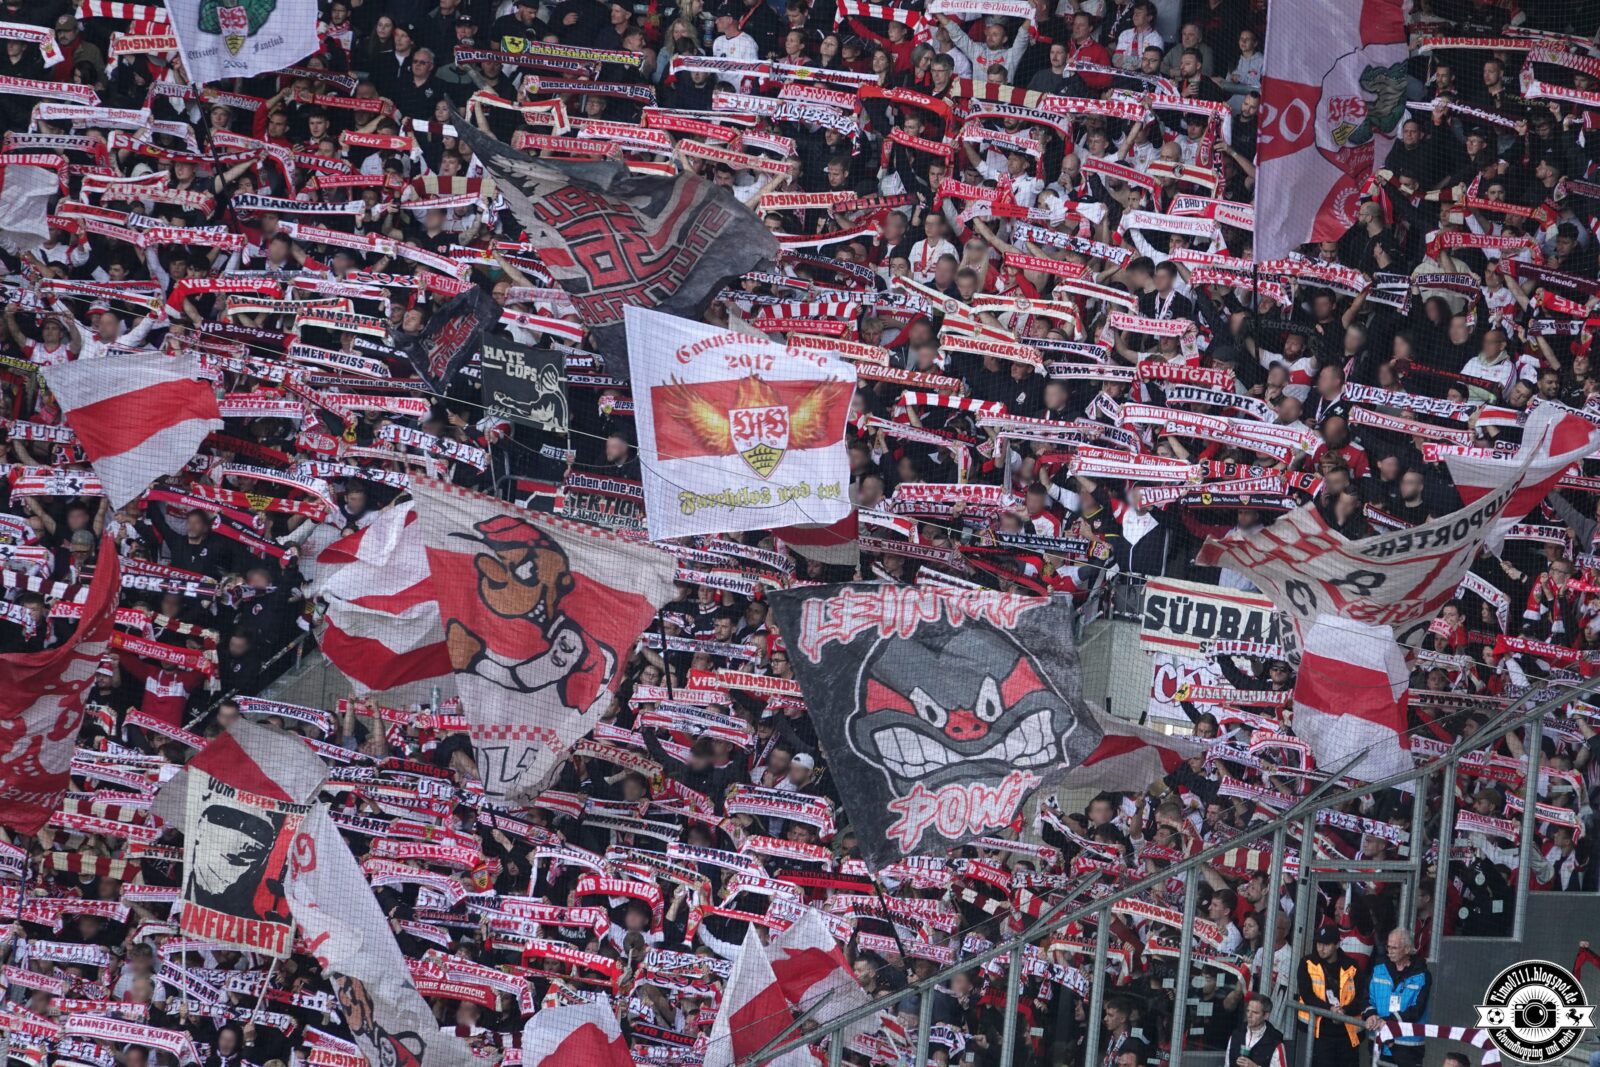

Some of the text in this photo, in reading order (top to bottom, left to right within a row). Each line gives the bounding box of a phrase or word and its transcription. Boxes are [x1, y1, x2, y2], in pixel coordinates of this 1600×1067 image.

[1218, 210, 1253, 225] FANUC
[182, 277, 212, 288] VfB
[200, 321, 223, 333] VfB
[290, 344, 325, 361] MMER
[483, 344, 525, 366] HATE
[724, 352, 777, 373] 2017
[505, 361, 538, 382] COPS
[857, 363, 909, 380] NIEMALS
[1141, 364, 1232, 389] STUTTGART
[1166, 421, 1196, 435] Bad
[725, 671, 754, 685] WIR
[758, 676, 792, 692] SIND
[180, 902, 290, 954] INFIZIERT
[551, 943, 616, 968] Stuttgart
[69, 1017, 184, 1045] CANNSTATTER KURVE
